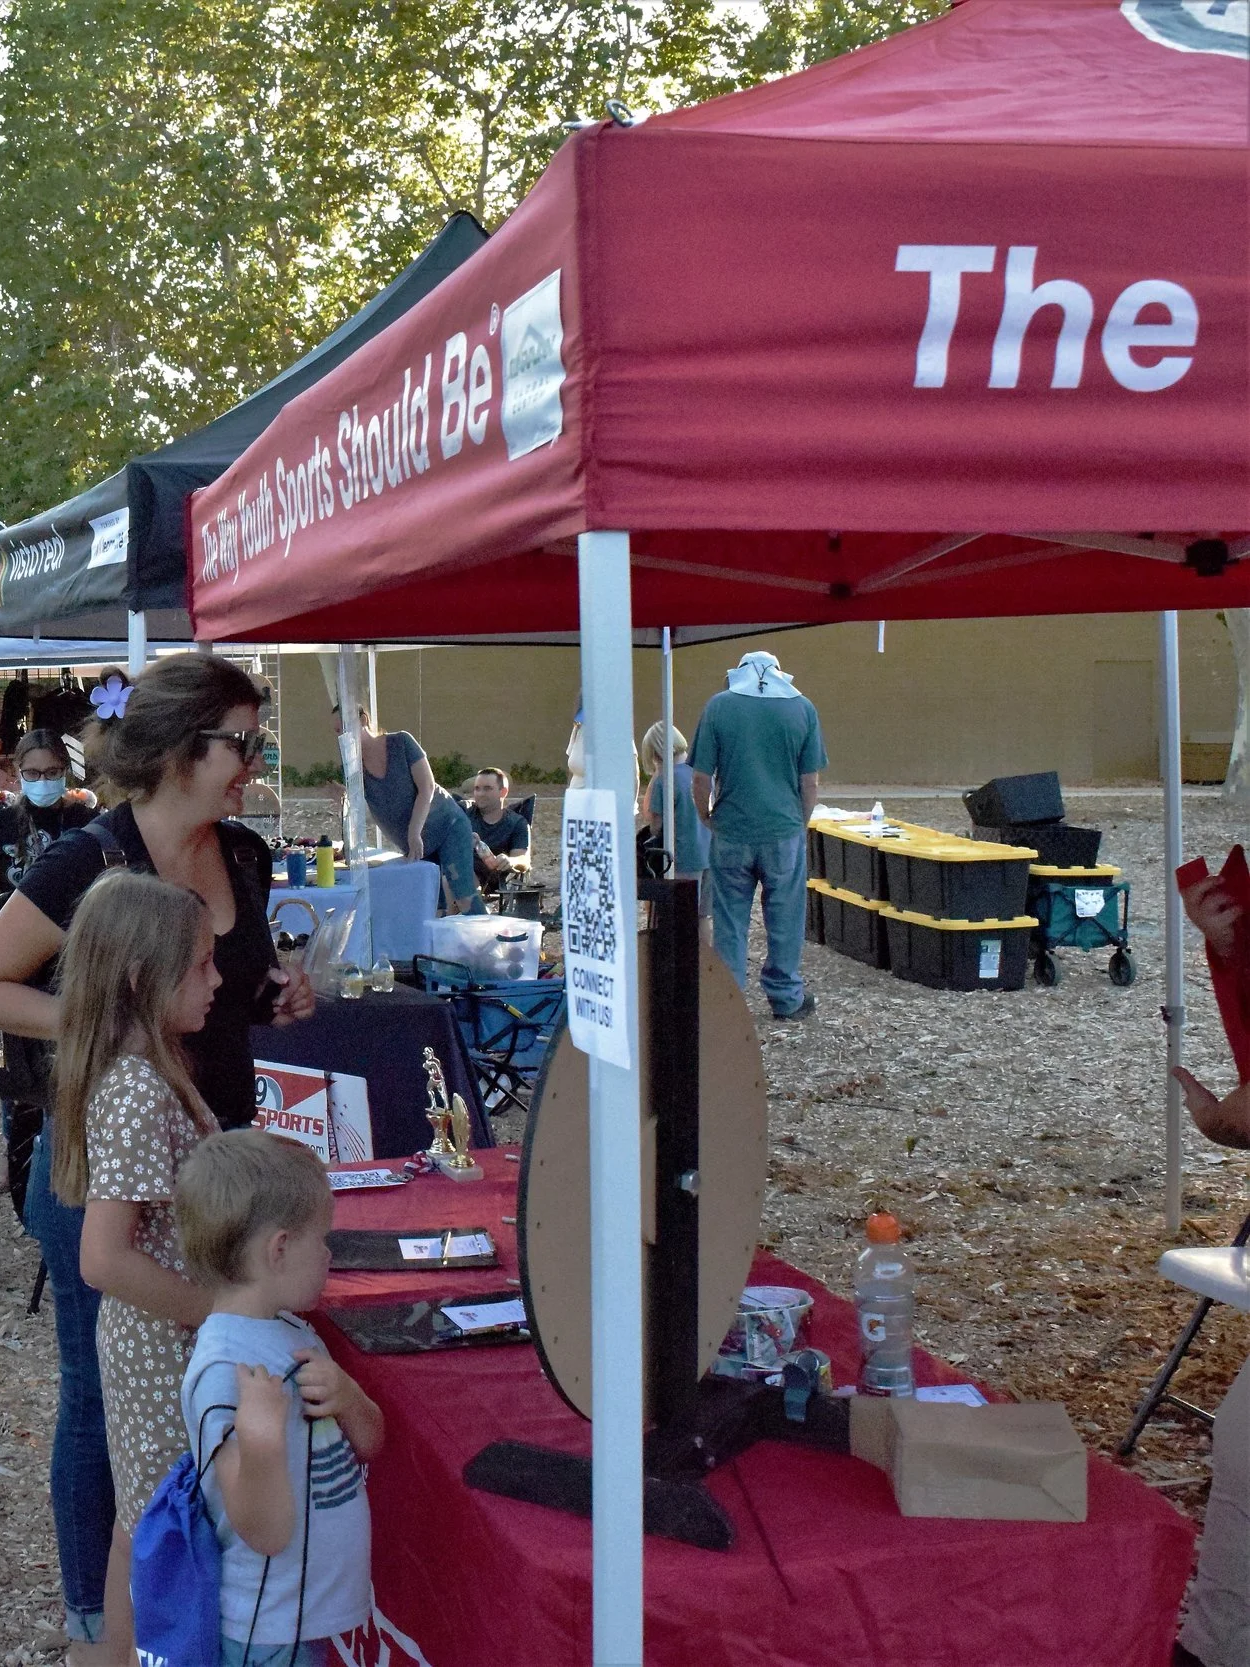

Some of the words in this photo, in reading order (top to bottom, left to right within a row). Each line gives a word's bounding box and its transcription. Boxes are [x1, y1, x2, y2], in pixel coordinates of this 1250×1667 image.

[895, 244, 1200, 393] The
[202, 522, 218, 583] The
[217, 507, 239, 585] Way
[238, 472, 274, 561] Youth
[276, 436, 335, 558] Sports
[337, 352, 432, 510] Should
[572, 966, 614, 999] CONNECT
[575, 994, 597, 1025] WITH
[597, 1002, 613, 1029] US!
[251, 1106, 325, 1137] SPORTS
